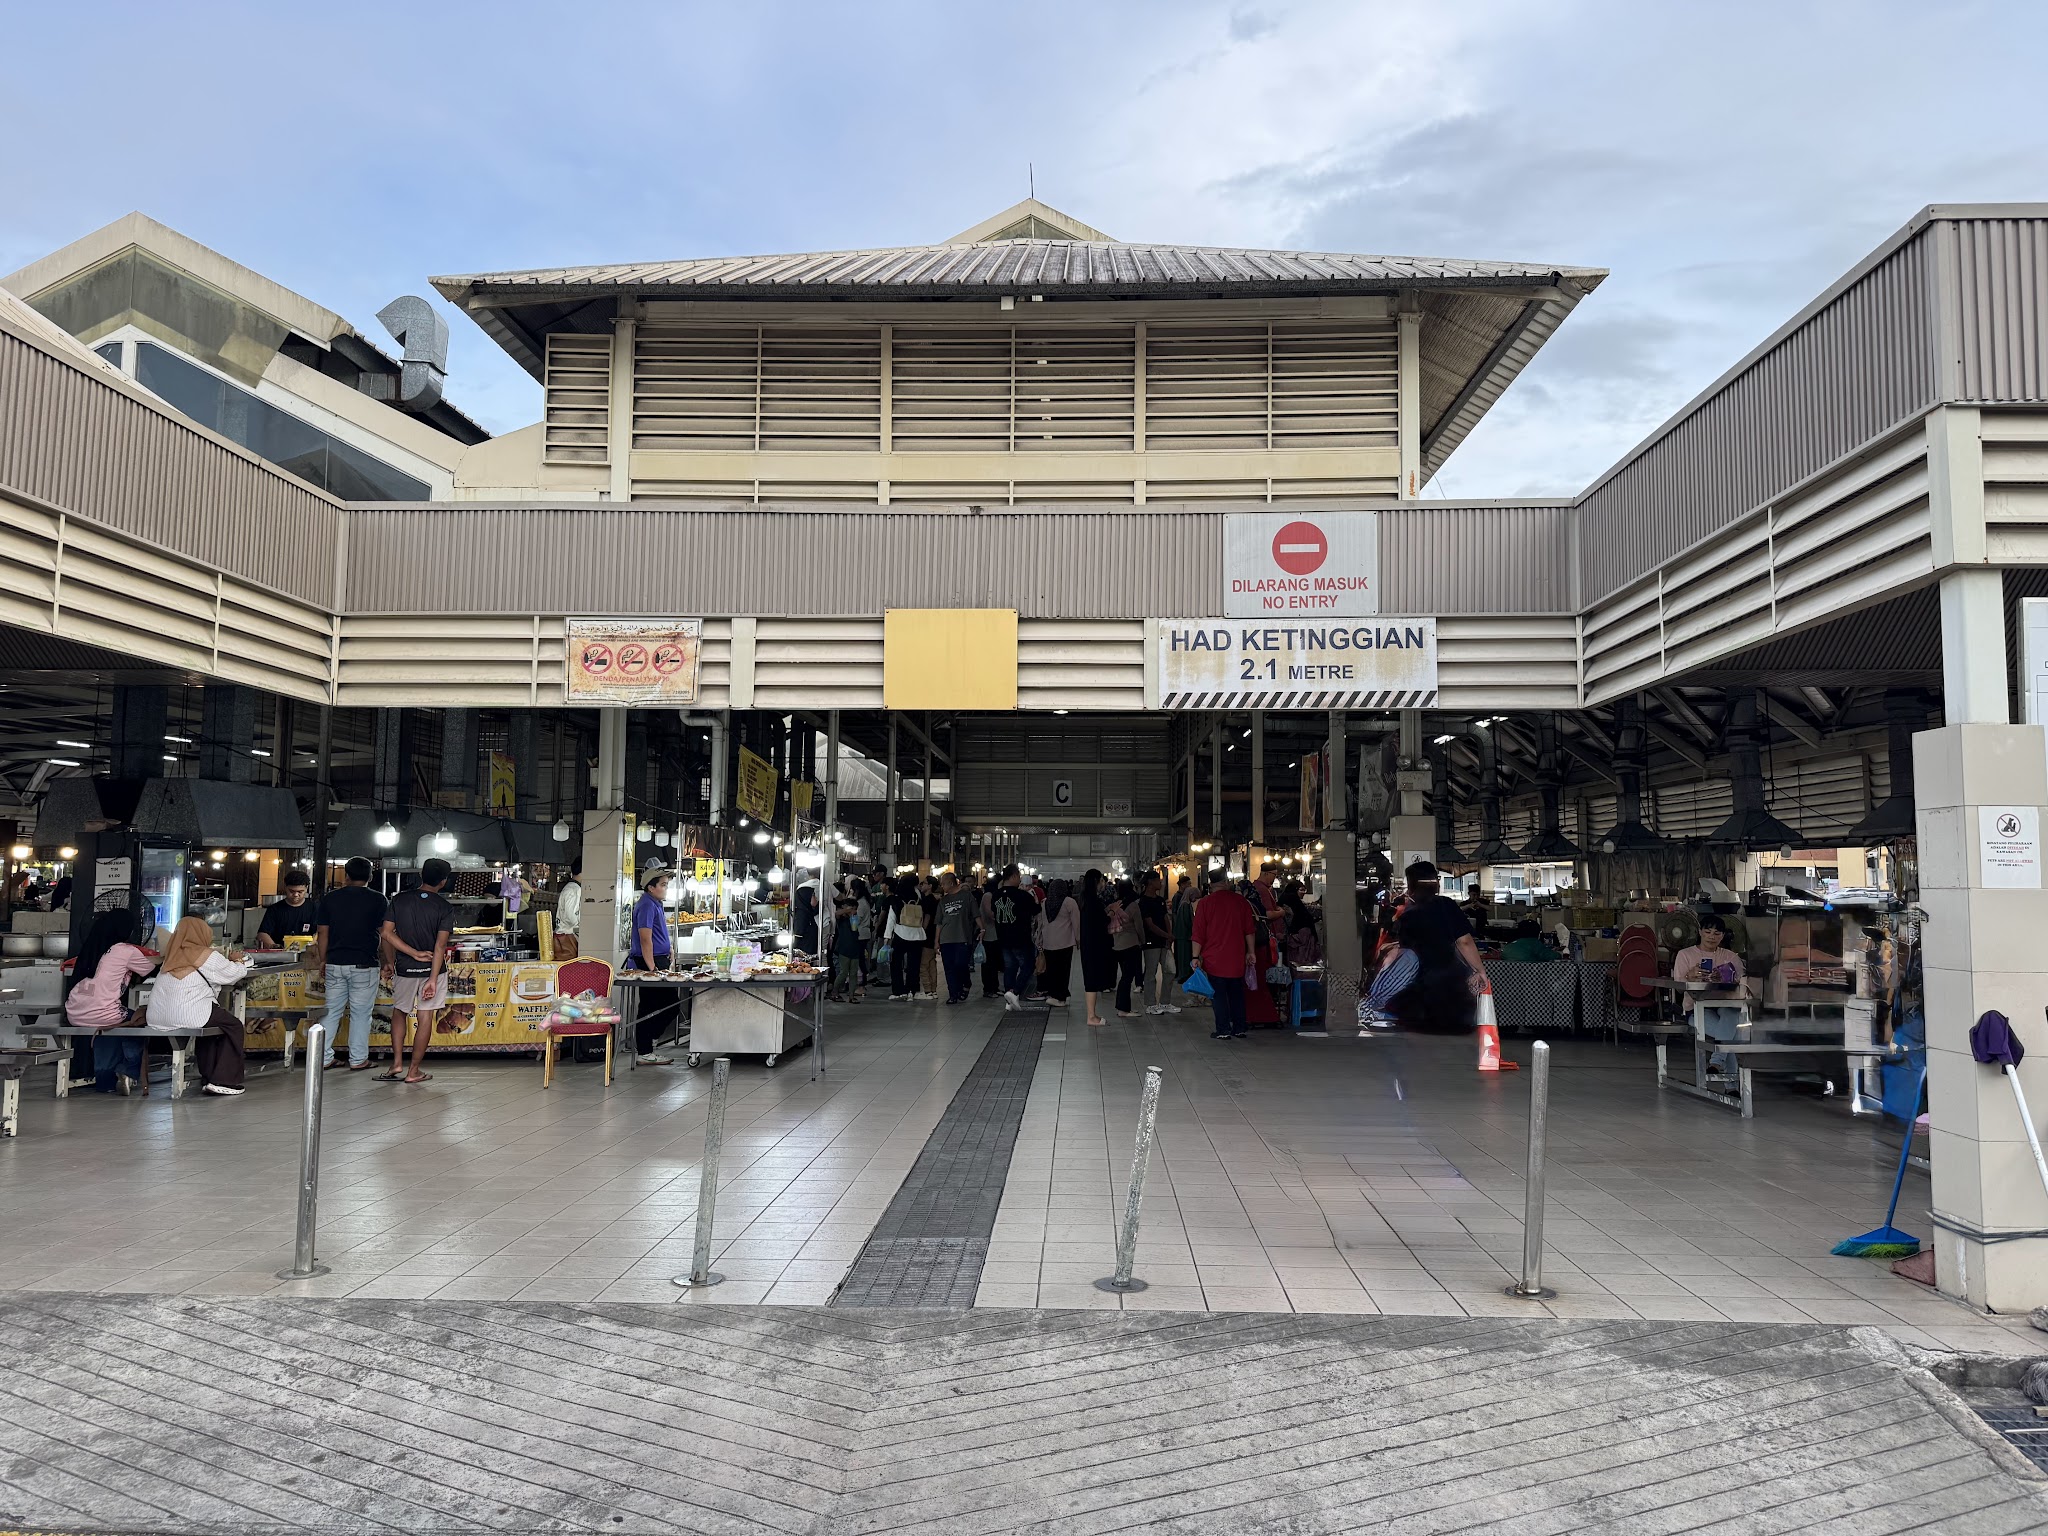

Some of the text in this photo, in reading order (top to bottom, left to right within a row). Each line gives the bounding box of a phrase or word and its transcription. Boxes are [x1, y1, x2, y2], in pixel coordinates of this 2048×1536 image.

[1232, 576, 1369, 593] DILARANG MASUK
[1262, 595, 1339, 609] NO ENTRY
[1171, 627, 1424, 651] HAD KETINGGIAN
[1240, 658, 1354, 680] 2.1 METRE
[1055, 782, 1069, 804] C
